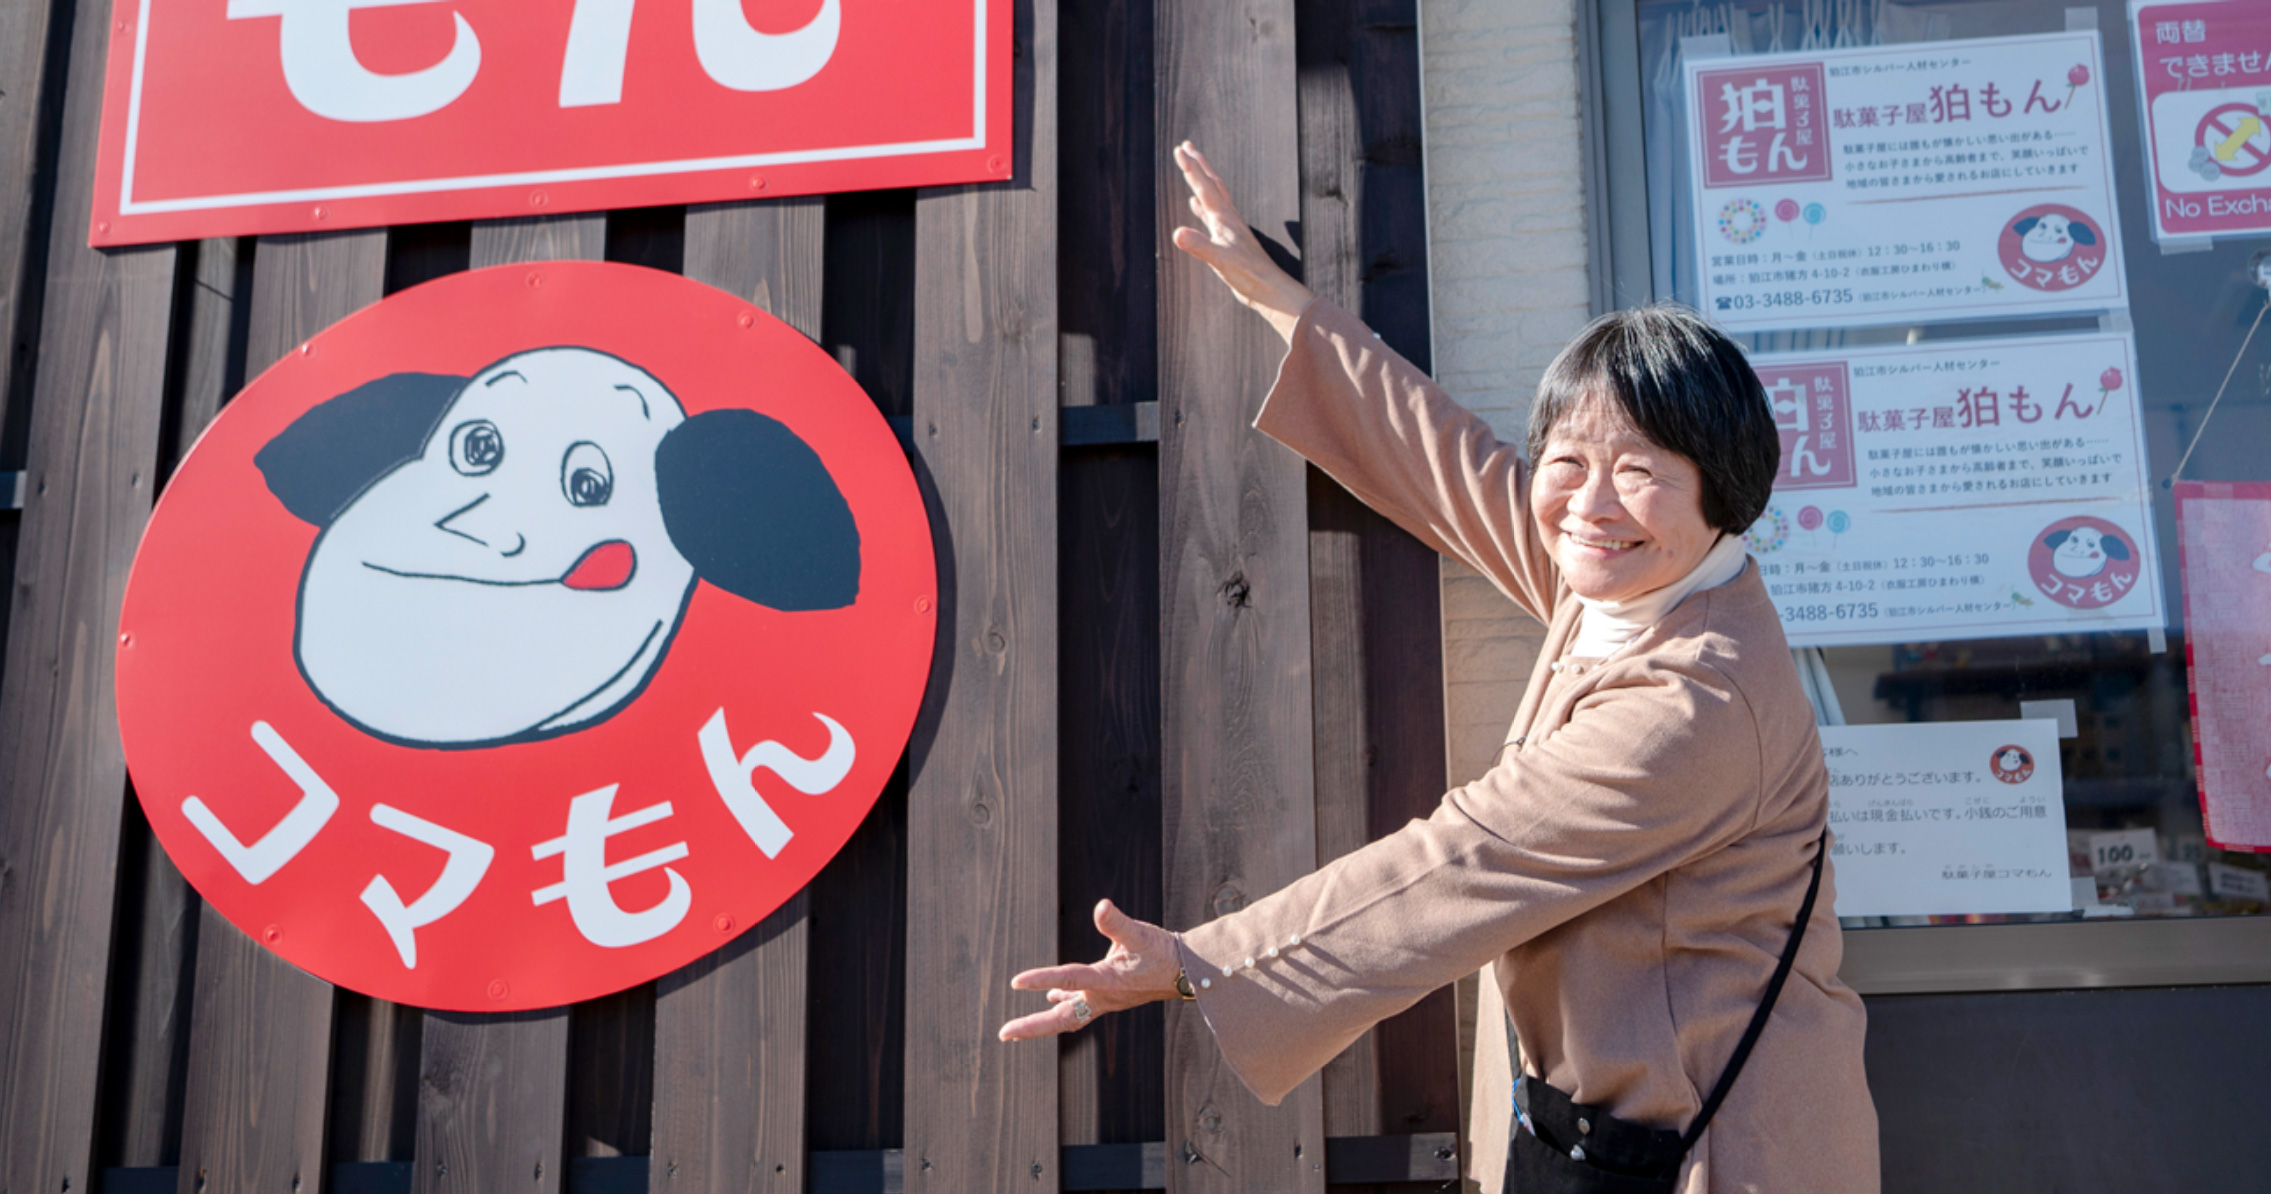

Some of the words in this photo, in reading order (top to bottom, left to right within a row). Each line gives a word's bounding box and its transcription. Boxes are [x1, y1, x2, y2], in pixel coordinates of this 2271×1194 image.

[2156, 19, 2206, 44] 両替
[1718, 78, 1787, 134] 狛
[1718, 132, 1808, 174] もん
[2166, 198, 2201, 219] No
[2010, 256, 2099, 288] コマもん
[2040, 572, 2133, 604] コマもん
[181, 706, 857, 969] コマもん
[2098, 844, 2133, 865] 100
